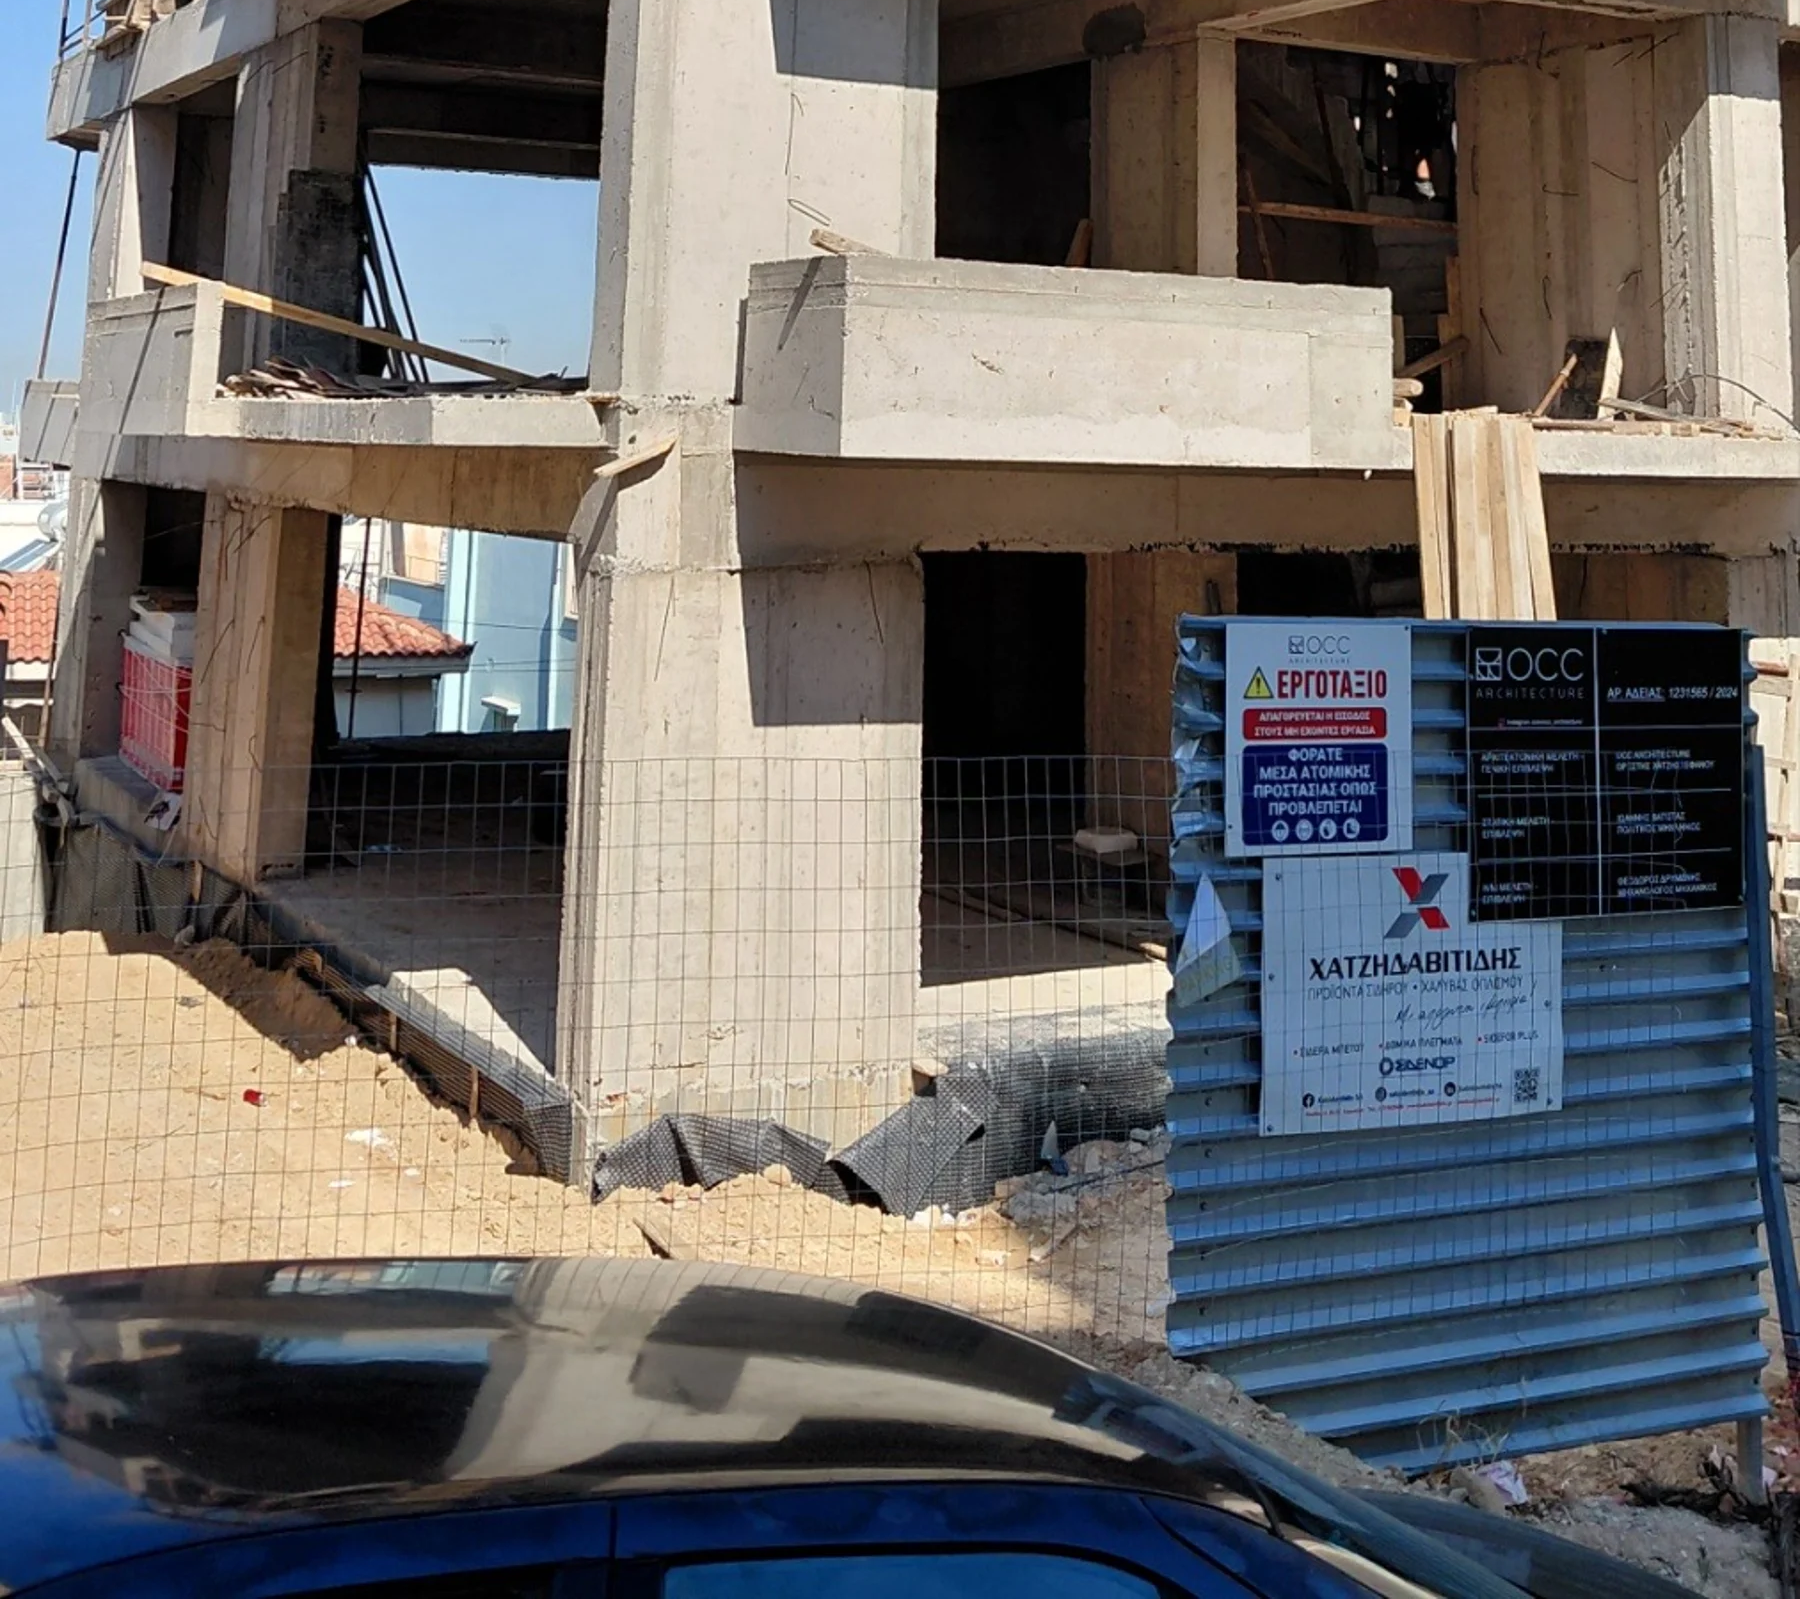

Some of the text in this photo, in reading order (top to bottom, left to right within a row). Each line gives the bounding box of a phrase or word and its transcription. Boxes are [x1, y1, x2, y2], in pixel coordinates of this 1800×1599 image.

[1306, 635, 1351, 655] OCC
[1506, 647, 1584, 681] OCC
[1277, 669, 1388, 700] ΕΡΓΟΤΑΞΙΟ
[1715, 685, 1739, 698] 2024
[1475, 687, 1586, 700] ARCHITECTURE
[1259, 710, 1371, 722] ΑΠΑΓΟΡΕΥΕΤΑΙ Η ΕΙΣΟΔΟΣ
[1254, 726, 1283, 737] ΣΤΟΥΣ
[1284, 726, 1299, 736] ΜΗ
[1300, 725, 1340, 736] ΕΧΟΝΤΕΣ
[1287, 747, 1344, 762] ΦΟΡΑΤΕ
[1259, 764, 1371, 780] ΜΕΣΑ ΑΤΟΜΙΚΗΣ
[1253, 781, 1377, 798] ΠΡΟΣΤΑΣΙΑΣ ΟΠΩΣ
[1268, 799, 1363, 816] ΠΡΟΒΛΕΠΕΤΑΙ
[1309, 946, 1522, 982] ΧΑΤΖΗΔΑΒΙΤΙΔΗΣ
